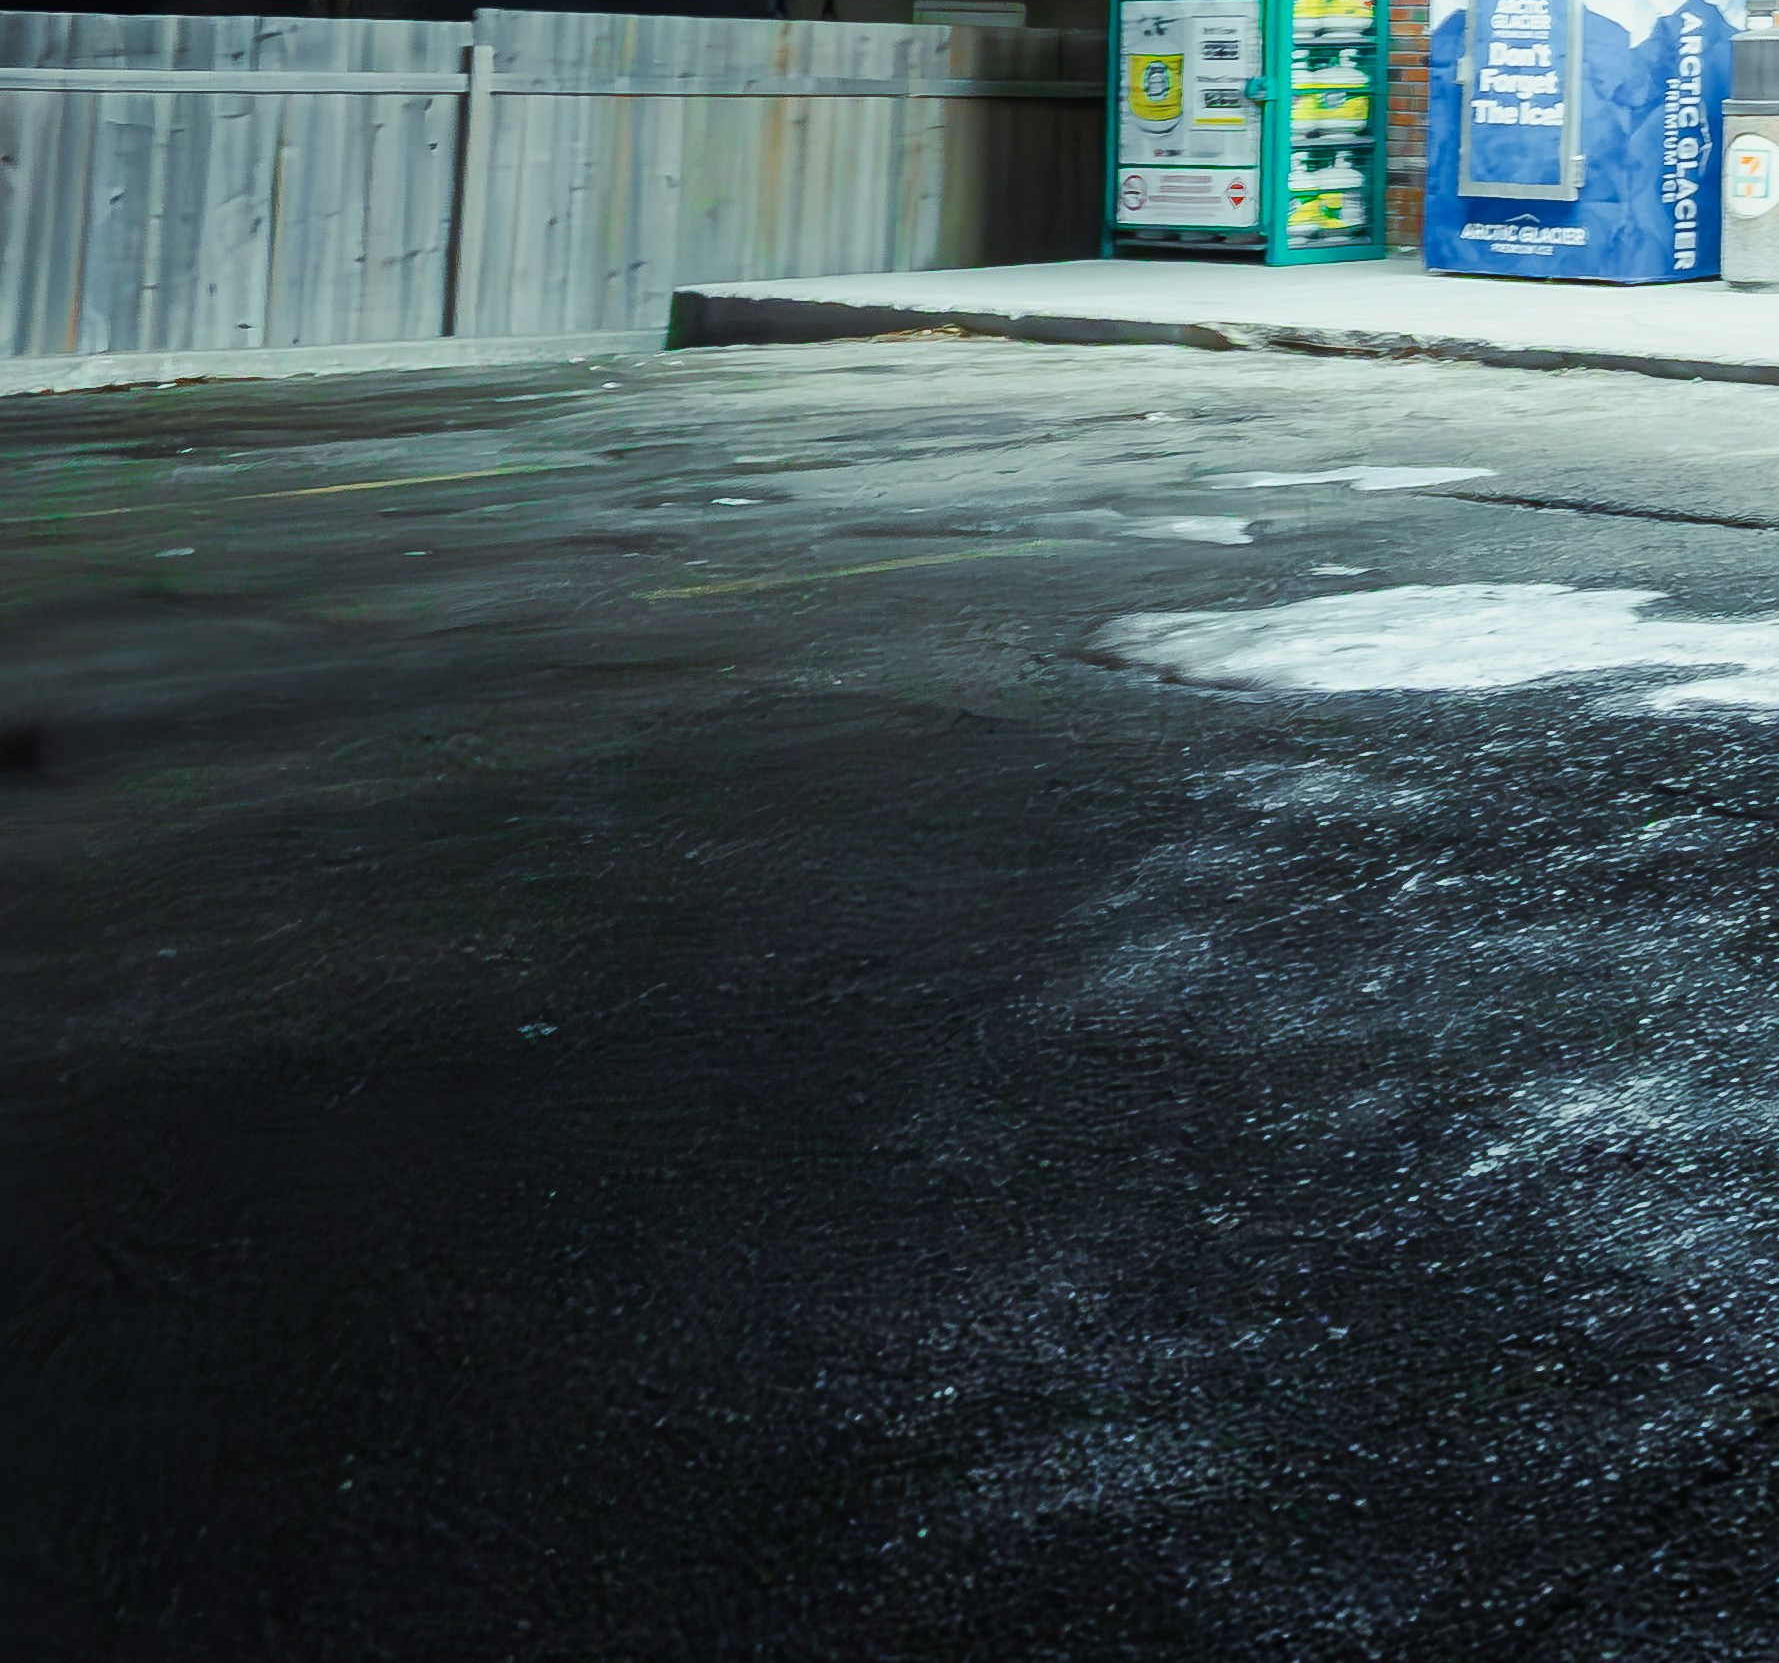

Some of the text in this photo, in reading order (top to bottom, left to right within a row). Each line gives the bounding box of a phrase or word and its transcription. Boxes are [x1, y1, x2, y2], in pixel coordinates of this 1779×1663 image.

[1480, 68, 1558, 99] Forget
[1471, 99, 1518, 124] The
[1673, 11, 1703, 271] ARCTIC GLACIER
